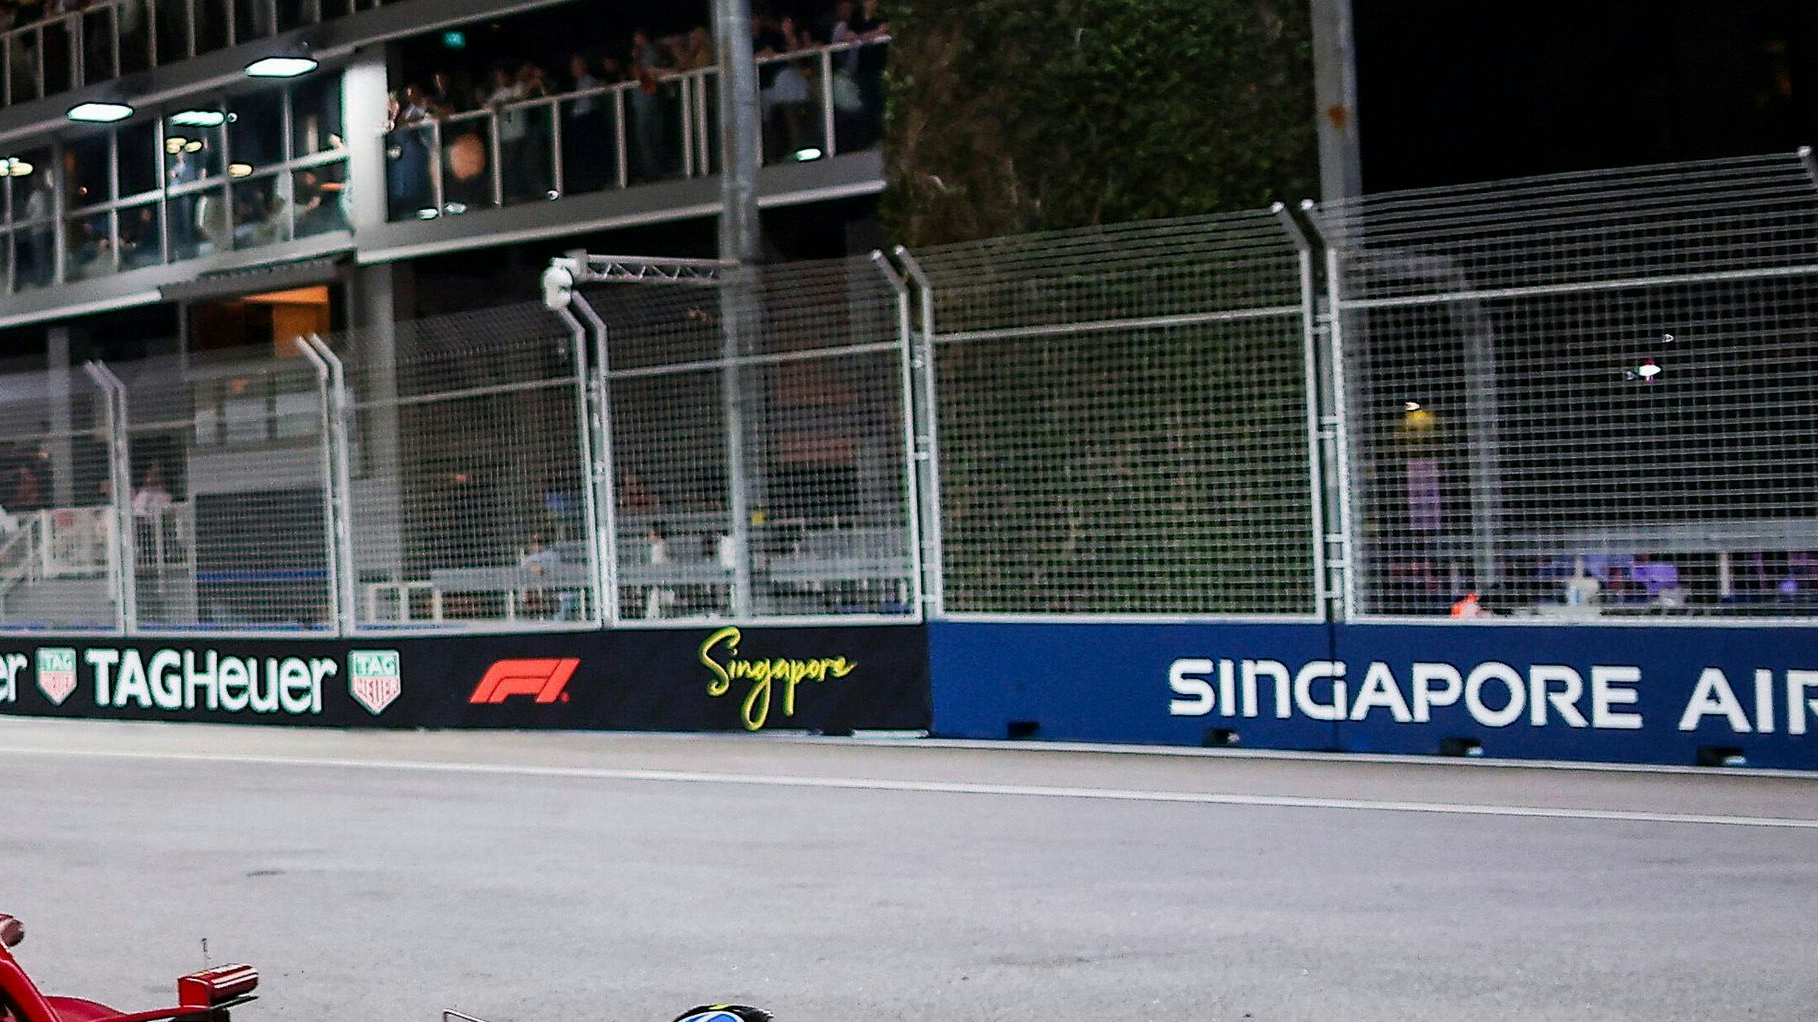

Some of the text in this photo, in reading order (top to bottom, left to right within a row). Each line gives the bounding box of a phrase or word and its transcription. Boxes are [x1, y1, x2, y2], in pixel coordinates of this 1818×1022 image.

[356, 656, 396, 676] TAG
[698, 626, 856, 731] Singapore
[1169, 657, 1644, 730] SINGAPORE
